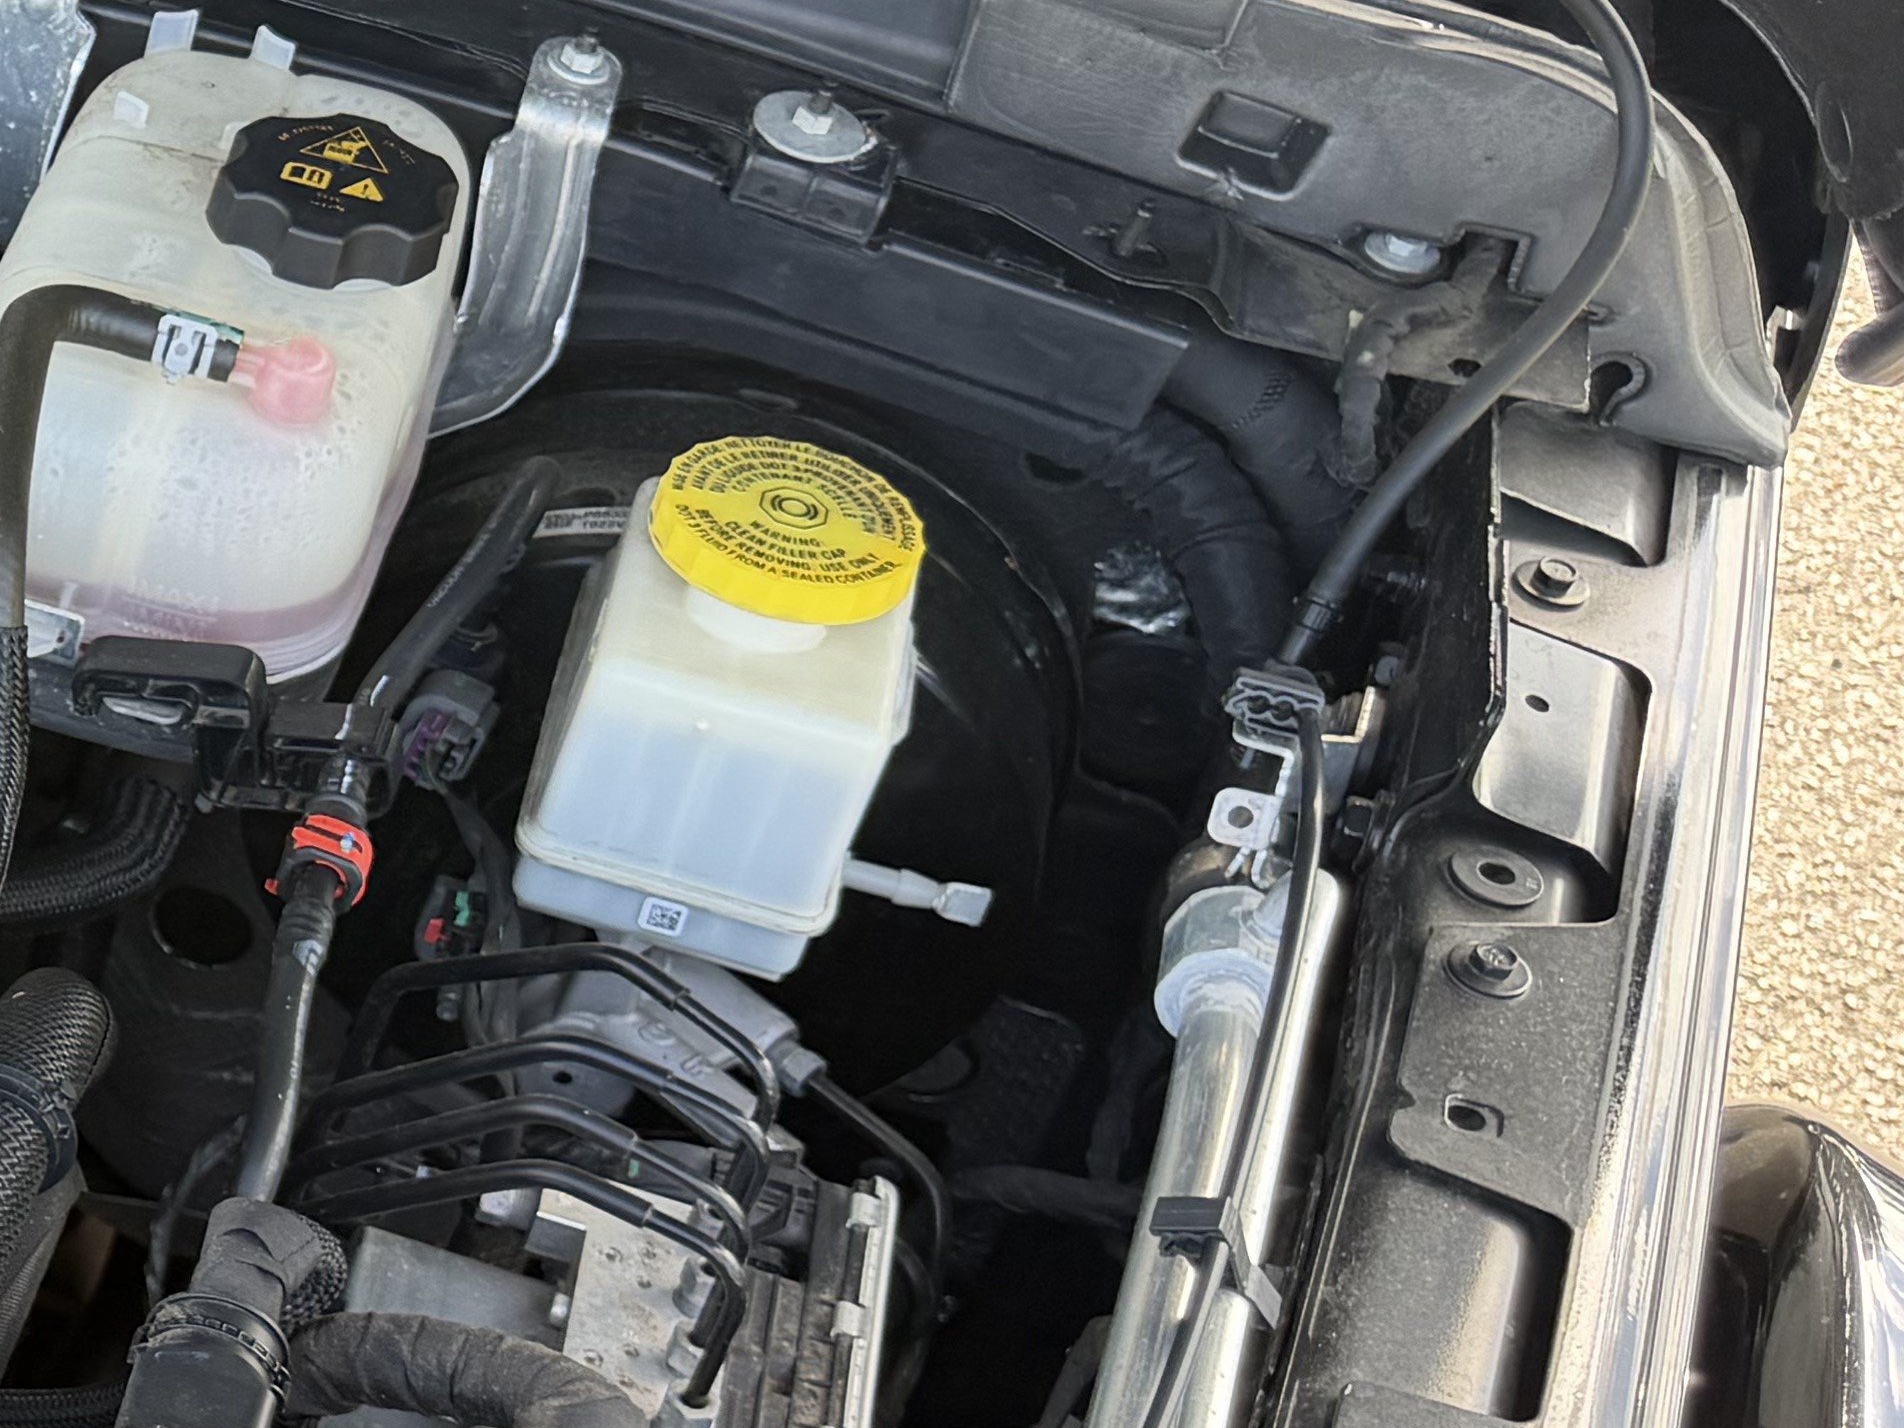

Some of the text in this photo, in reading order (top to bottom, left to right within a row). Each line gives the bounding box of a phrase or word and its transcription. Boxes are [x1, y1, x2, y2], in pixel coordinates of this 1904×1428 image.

[759, 462, 788, 470] DOT
[695, 509, 737, 542] BEFORE
[820, 561, 848, 572] USE
[848, 553, 880, 569] ONLY
[695, 528, 728, 551] FLUID
[726, 550, 766, 569] FROM
[781, 570, 835, 583] SEALED
[724, 521, 847, 560] CLEAN FILLER CAP
